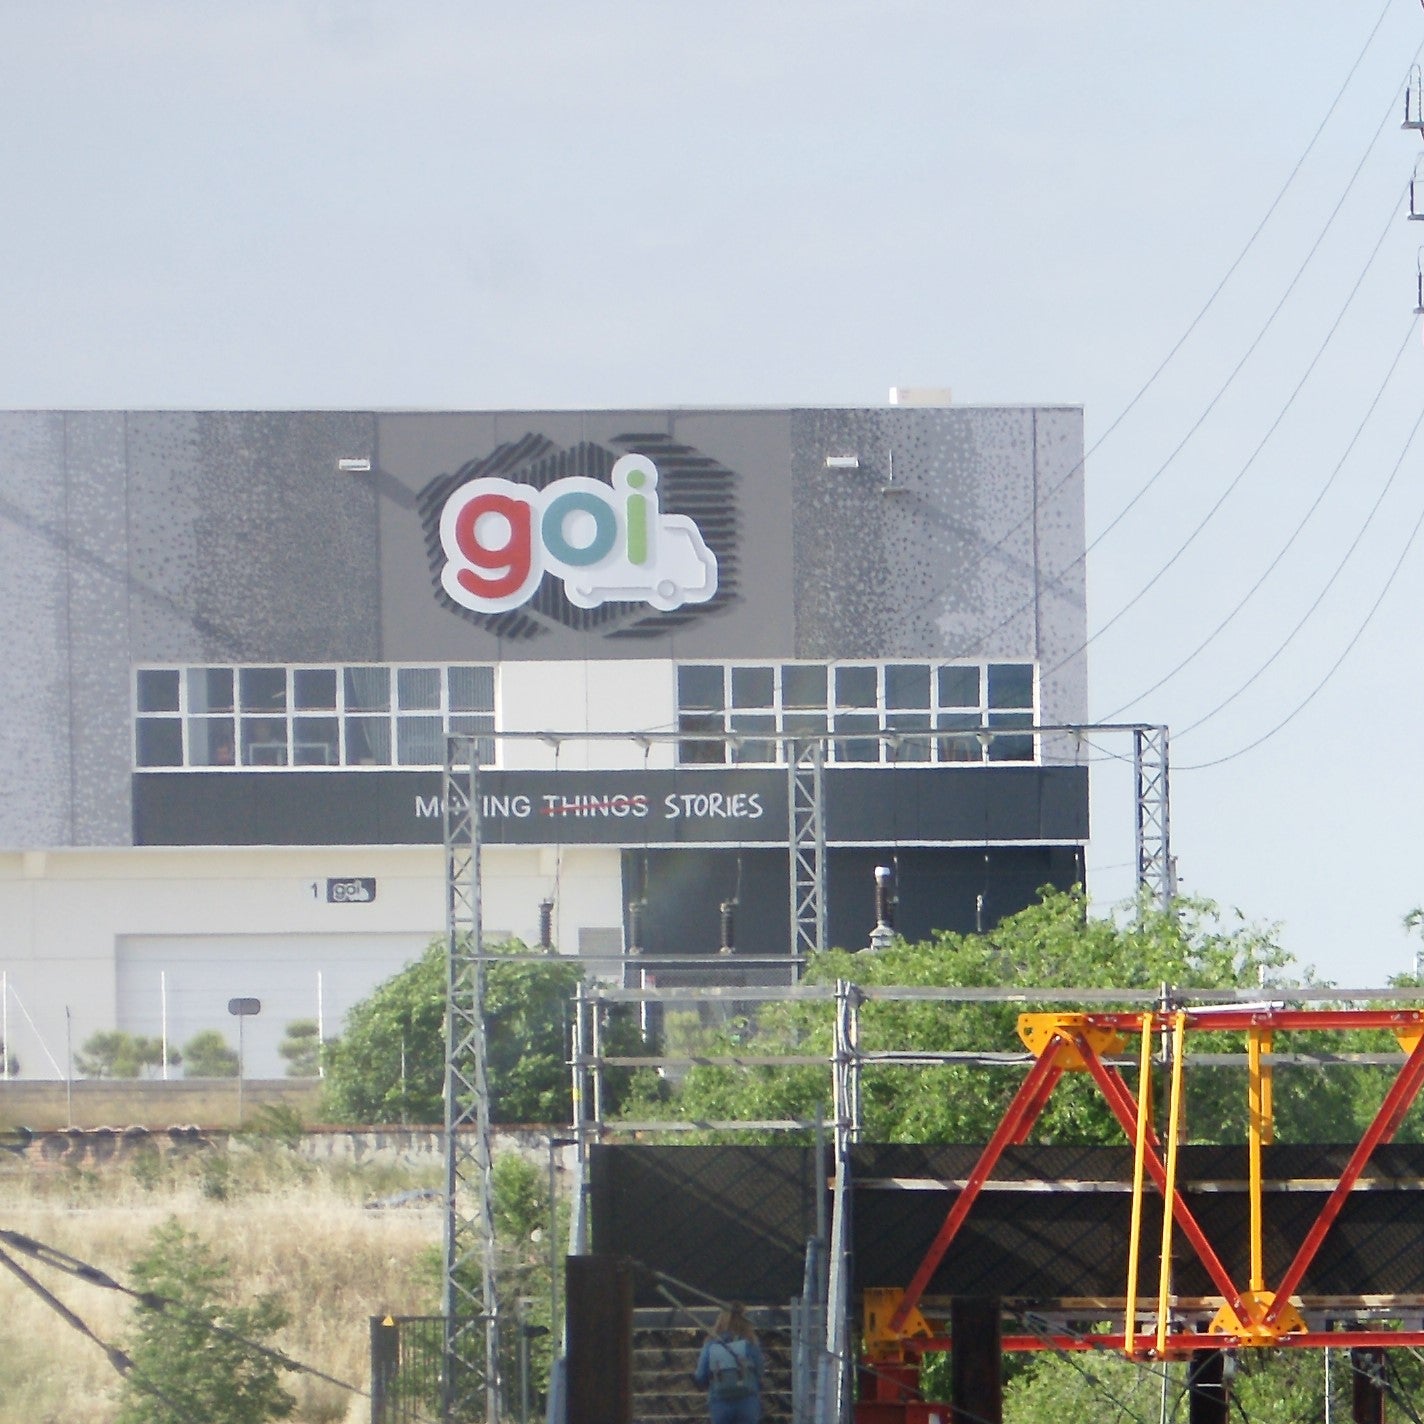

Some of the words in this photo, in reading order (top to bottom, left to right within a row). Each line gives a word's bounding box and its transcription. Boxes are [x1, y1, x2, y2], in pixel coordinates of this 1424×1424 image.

[455, 469, 648, 599] goi
[415, 795, 531, 818] MING
[543, 795, 648, 818] THINGS
[665, 793, 763, 818] STORIES
